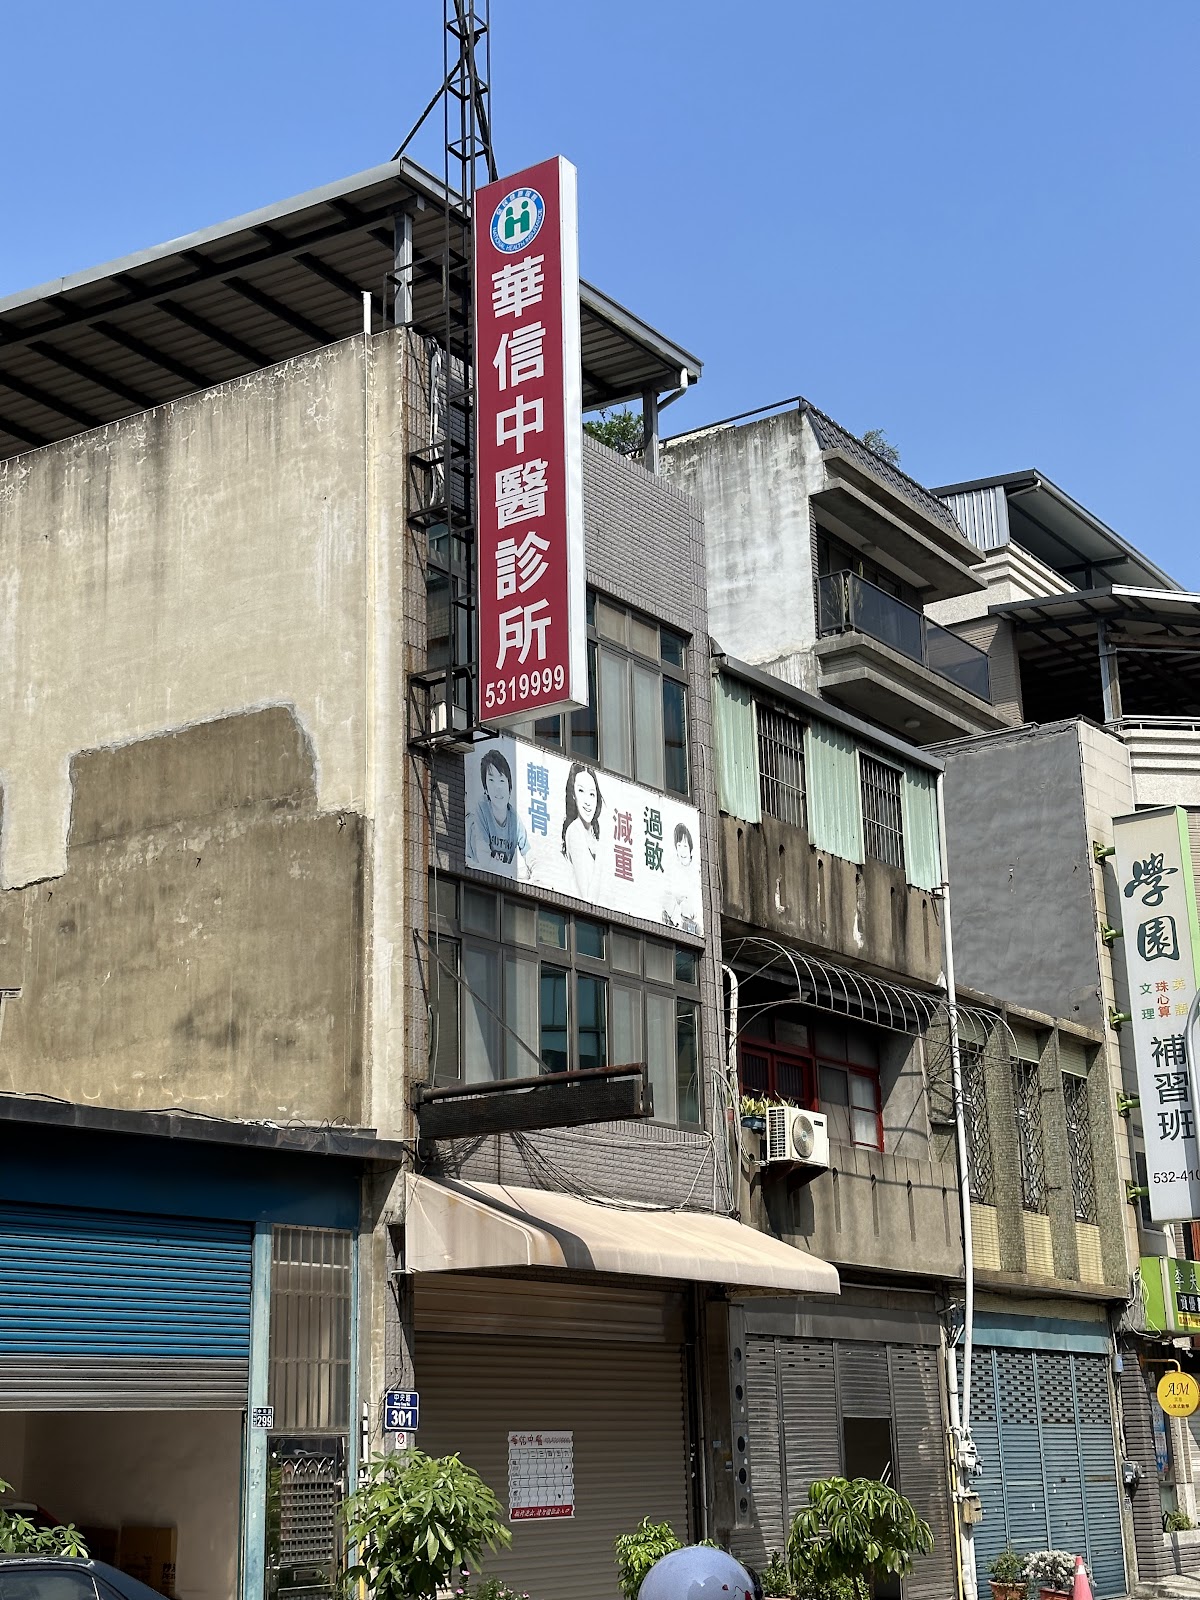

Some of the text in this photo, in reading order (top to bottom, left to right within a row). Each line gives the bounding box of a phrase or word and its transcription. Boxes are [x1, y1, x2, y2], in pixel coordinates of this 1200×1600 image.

[505, 240, 526, 251] HEALTH
[491, 253, 552, 671] 華信中醫診所
[485, 664, 565, 708] 5319999
[526, 761, 550, 837] 轉骨
[612, 807, 635, 883] 減重
[643, 806, 665, 874] 過敏
[1123, 852, 1180, 962] 學園
[1139, 982, 1155, 1020] 文理
[1155, 980, 1171, 1018] 珠心算
[1151, 1033, 1196, 1141] 補習班
[1180, 1295, 1200, 1312] 資優
[393, 1393, 411, 1402] 中央路
[1165, 1382, 1190, 1397] AM
[257, 1415, 272, 1427] 299
[391, 1409, 412, 1427] 301
